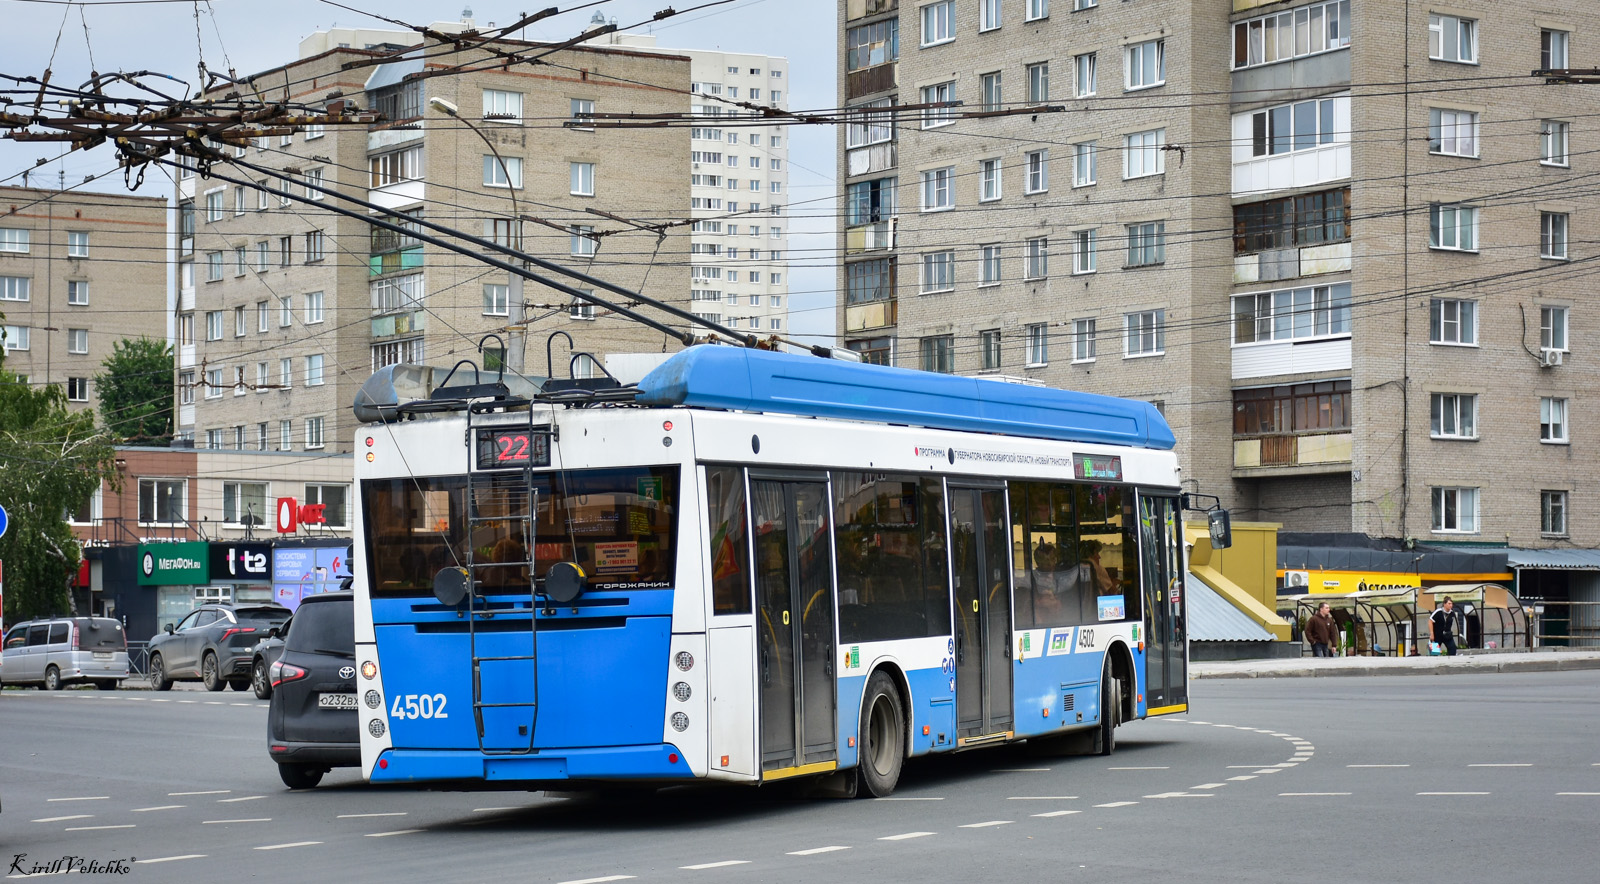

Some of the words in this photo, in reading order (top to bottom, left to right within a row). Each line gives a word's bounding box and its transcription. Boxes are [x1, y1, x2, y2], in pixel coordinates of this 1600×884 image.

[498, 435, 530, 461] 22
[918, 447, 946, 458] ПРОГРАММА
[954, 450, 982, 461] ГУБЕРНАТОРА
[982, 453, 1017, 463] НОВОСИБИРСКОЙ
[1016, 454, 1034, 464] ОБЛАСТИ
[240, 550, 267, 573] t2
[595, 581, 670, 589] ГОРОЖАНИН
[1078, 629, 1095, 648] 4502
[390, 693, 448, 720] 4502
